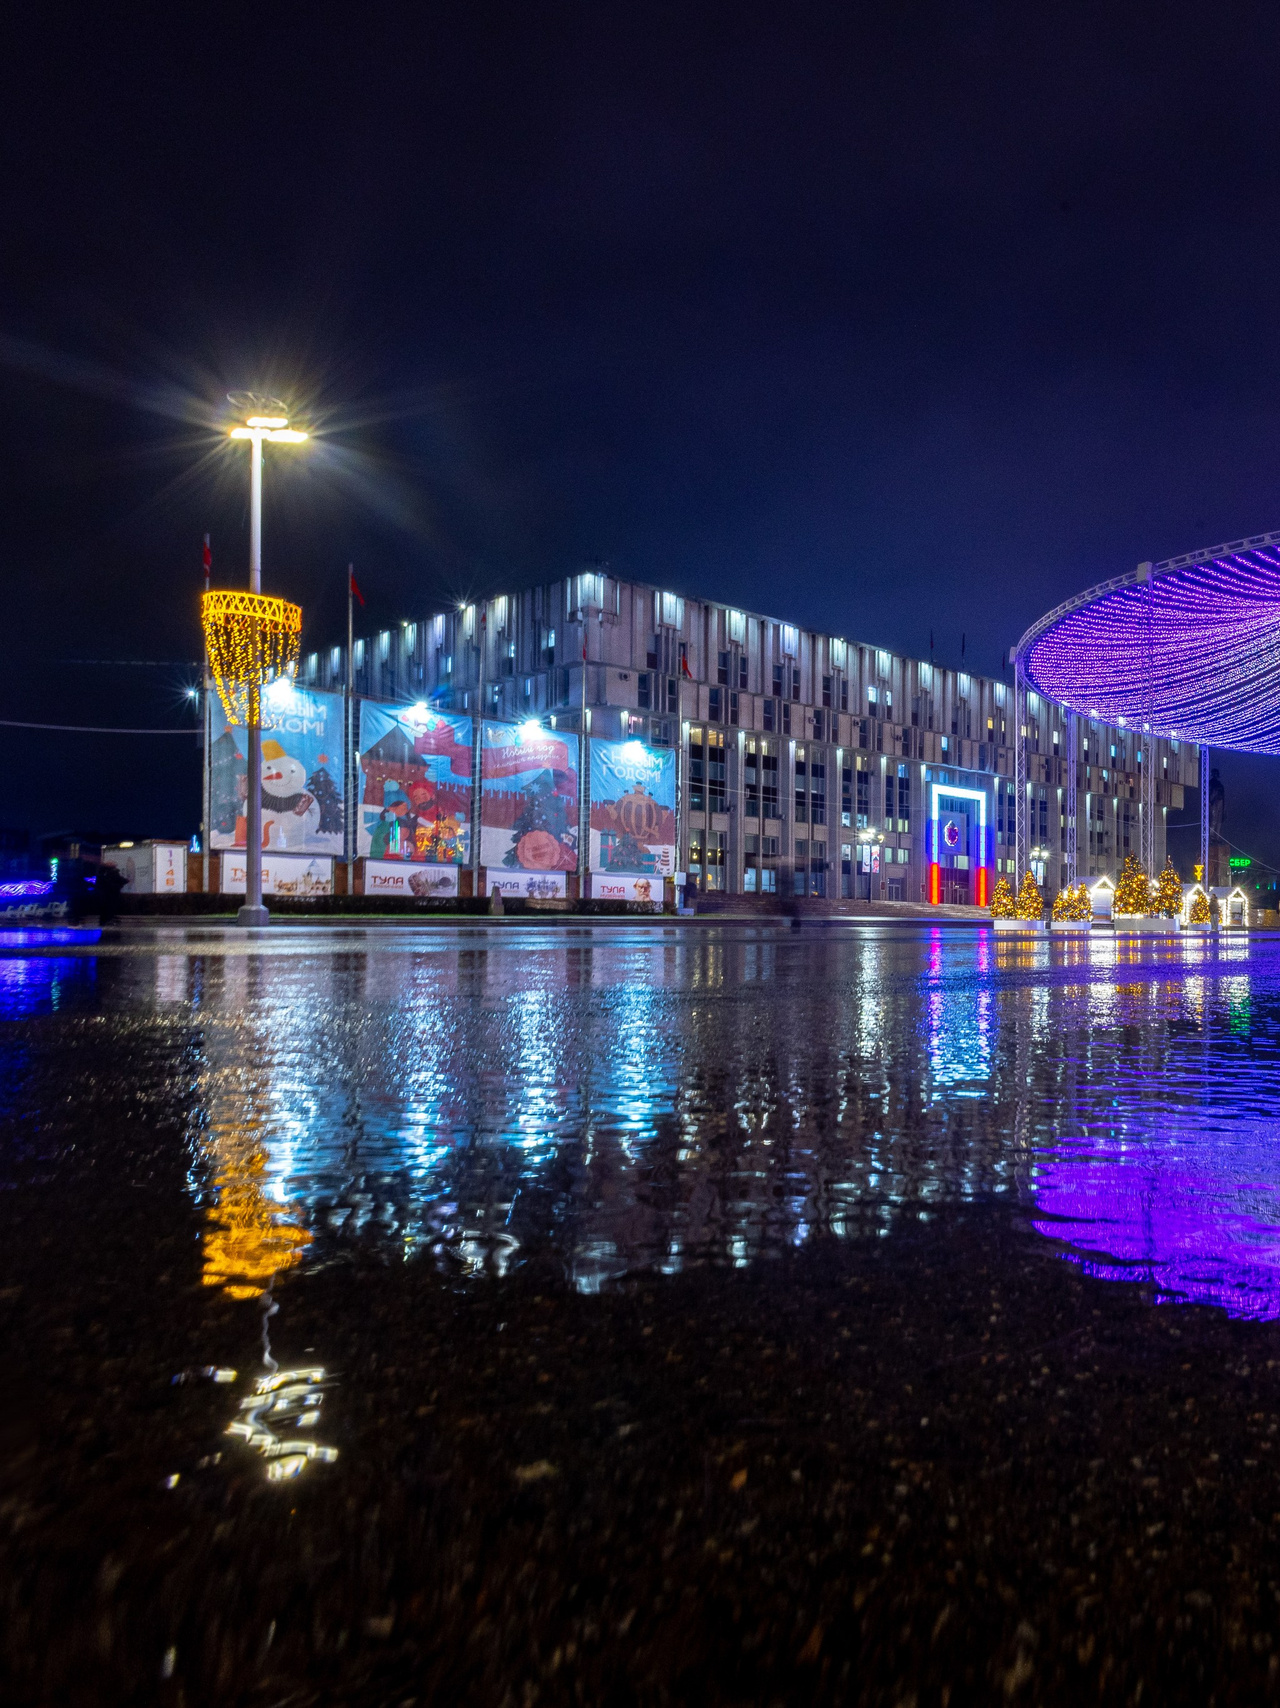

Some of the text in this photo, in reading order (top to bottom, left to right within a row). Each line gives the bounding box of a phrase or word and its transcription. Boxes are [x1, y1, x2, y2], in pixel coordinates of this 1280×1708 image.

[602, 764, 661, 783] ГОДОМ!
[1229, 858, 1251, 867] СБЕР
[371, 875, 404, 885] ТУЛА
[491, 881, 520, 890] ТУЛА
[600, 885, 626, 894] ТУЛА
